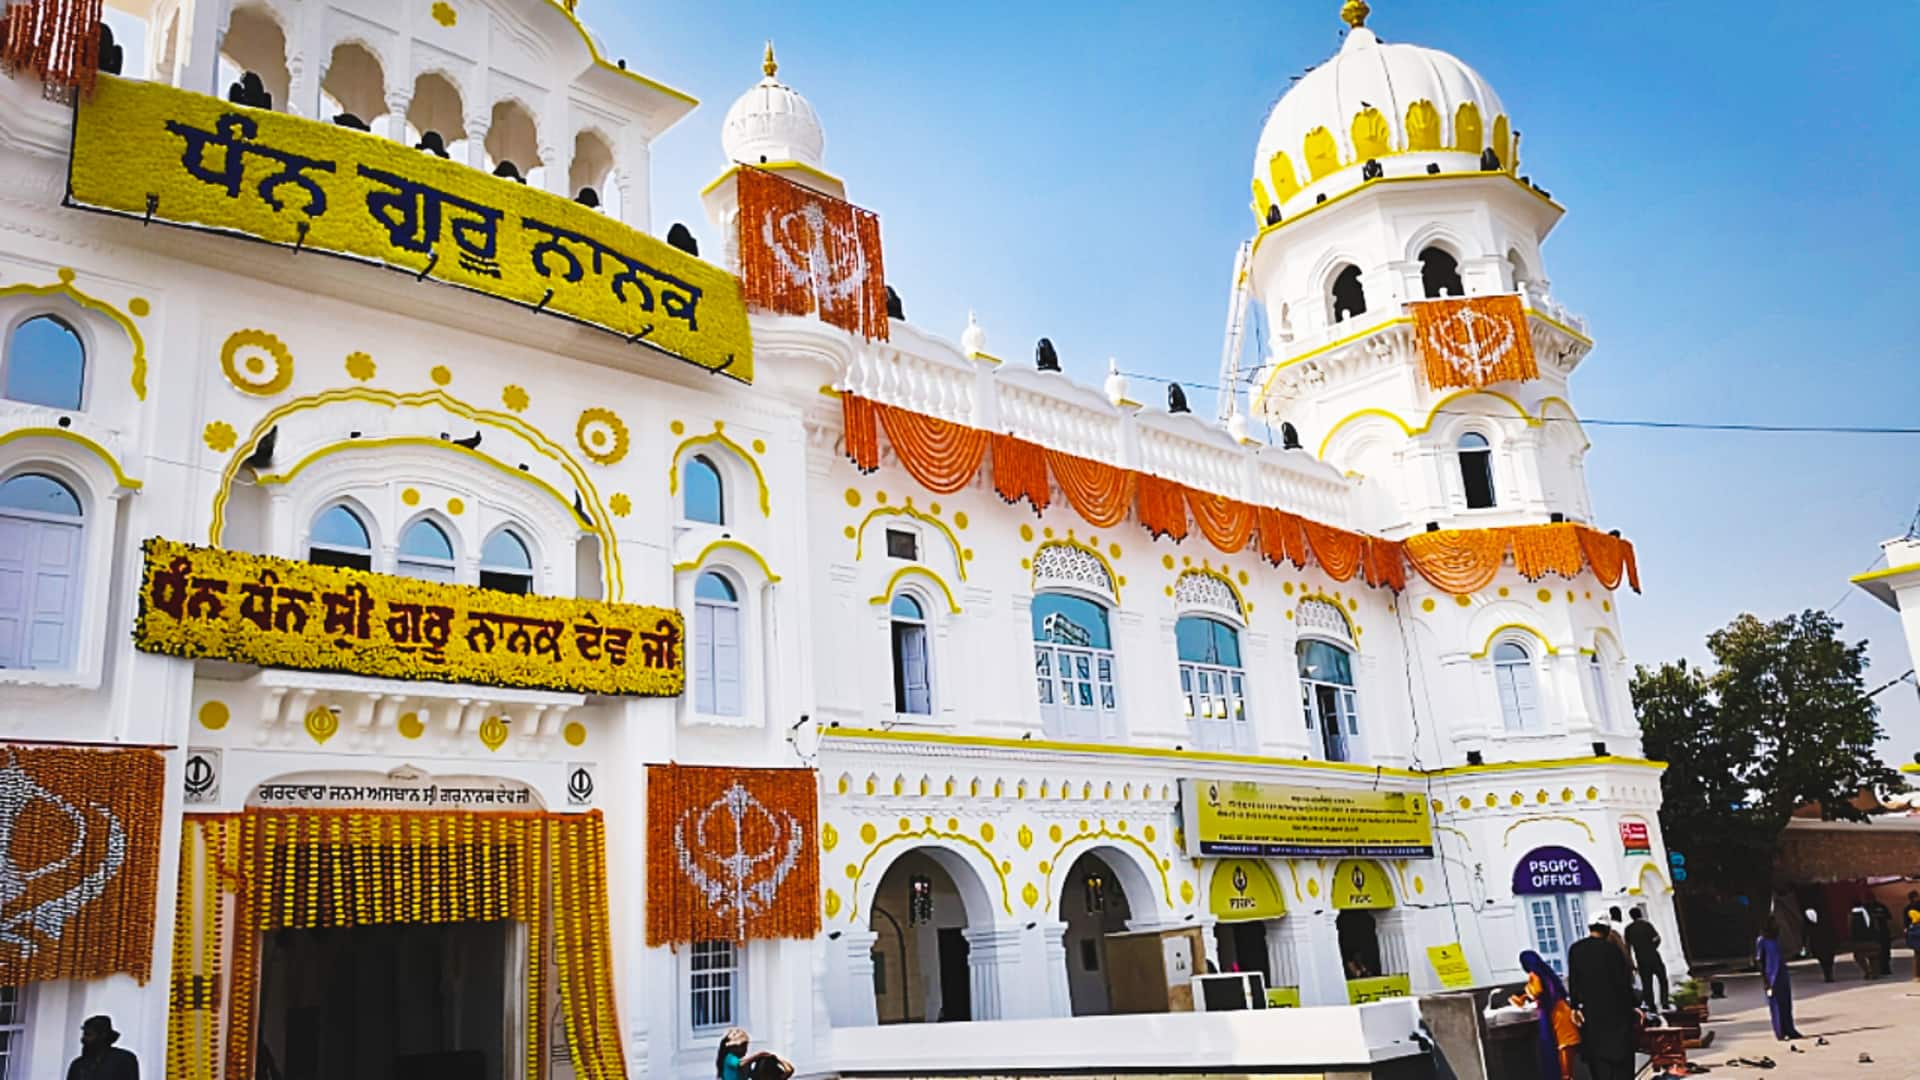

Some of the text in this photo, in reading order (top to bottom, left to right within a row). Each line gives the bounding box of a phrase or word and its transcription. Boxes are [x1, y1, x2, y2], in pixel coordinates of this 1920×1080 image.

[165, 113, 336, 218] ਧੰਨ
[520, 217, 702, 331] ਨਾਨਕ
[465, 612, 564, 662] ਨਾਨਕ
[574, 611, 632, 666] ਦੇਵ
[640, 618, 679, 669] ਜੀ
[1529, 859, 1579, 873] PSGPC
[1532, 872, 1581, 888] OFFICE
